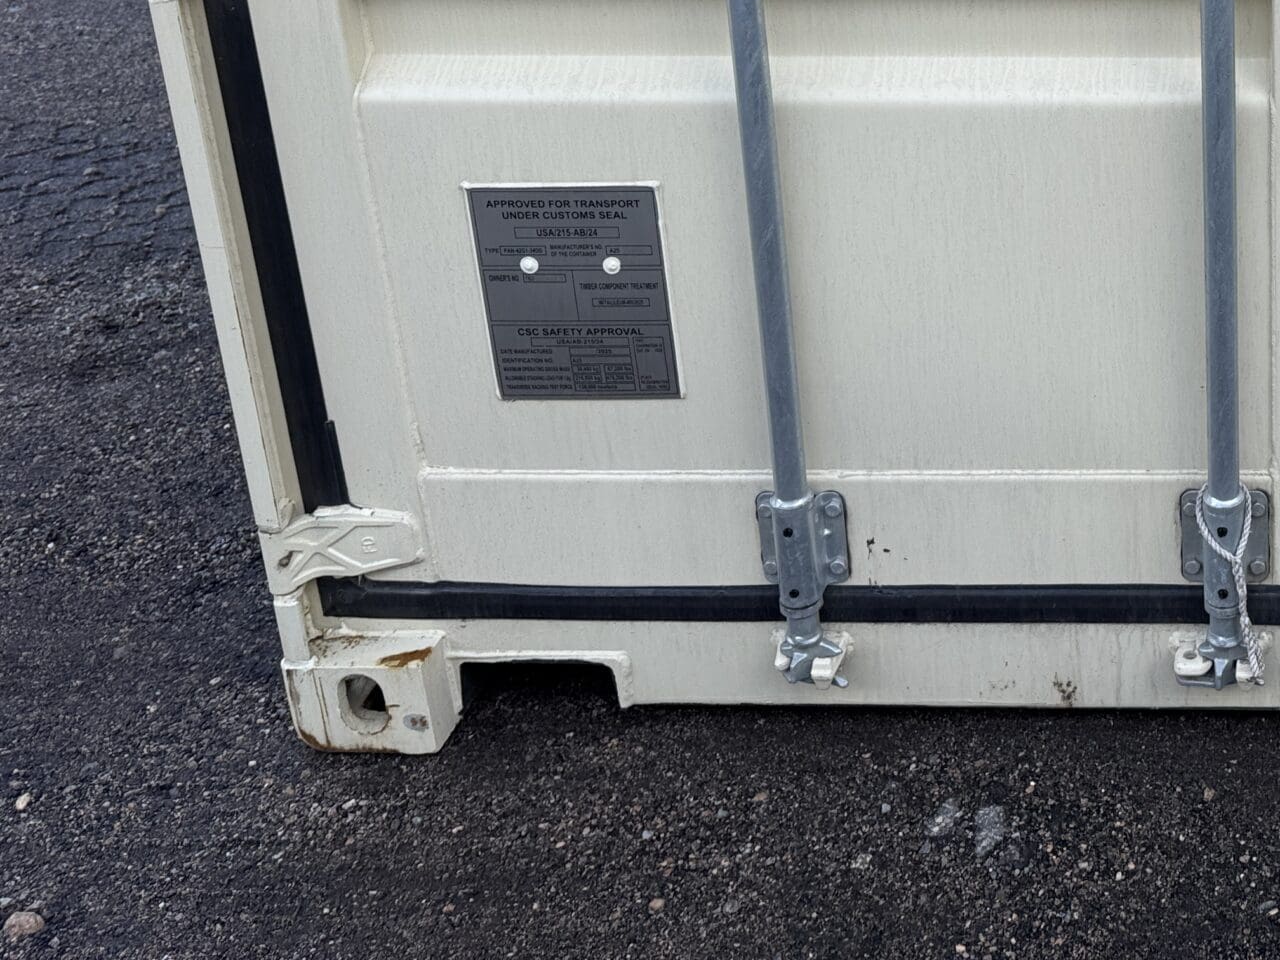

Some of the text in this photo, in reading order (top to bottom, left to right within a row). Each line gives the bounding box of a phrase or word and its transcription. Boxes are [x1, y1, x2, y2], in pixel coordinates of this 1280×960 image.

[486, 200, 640, 209] APPROVED FOR TRANSPORT
[502, 211, 627, 220] UNDER CUSTOMS SEAL
[518, 328, 644, 336] CSC SAFETY APPROVAL
